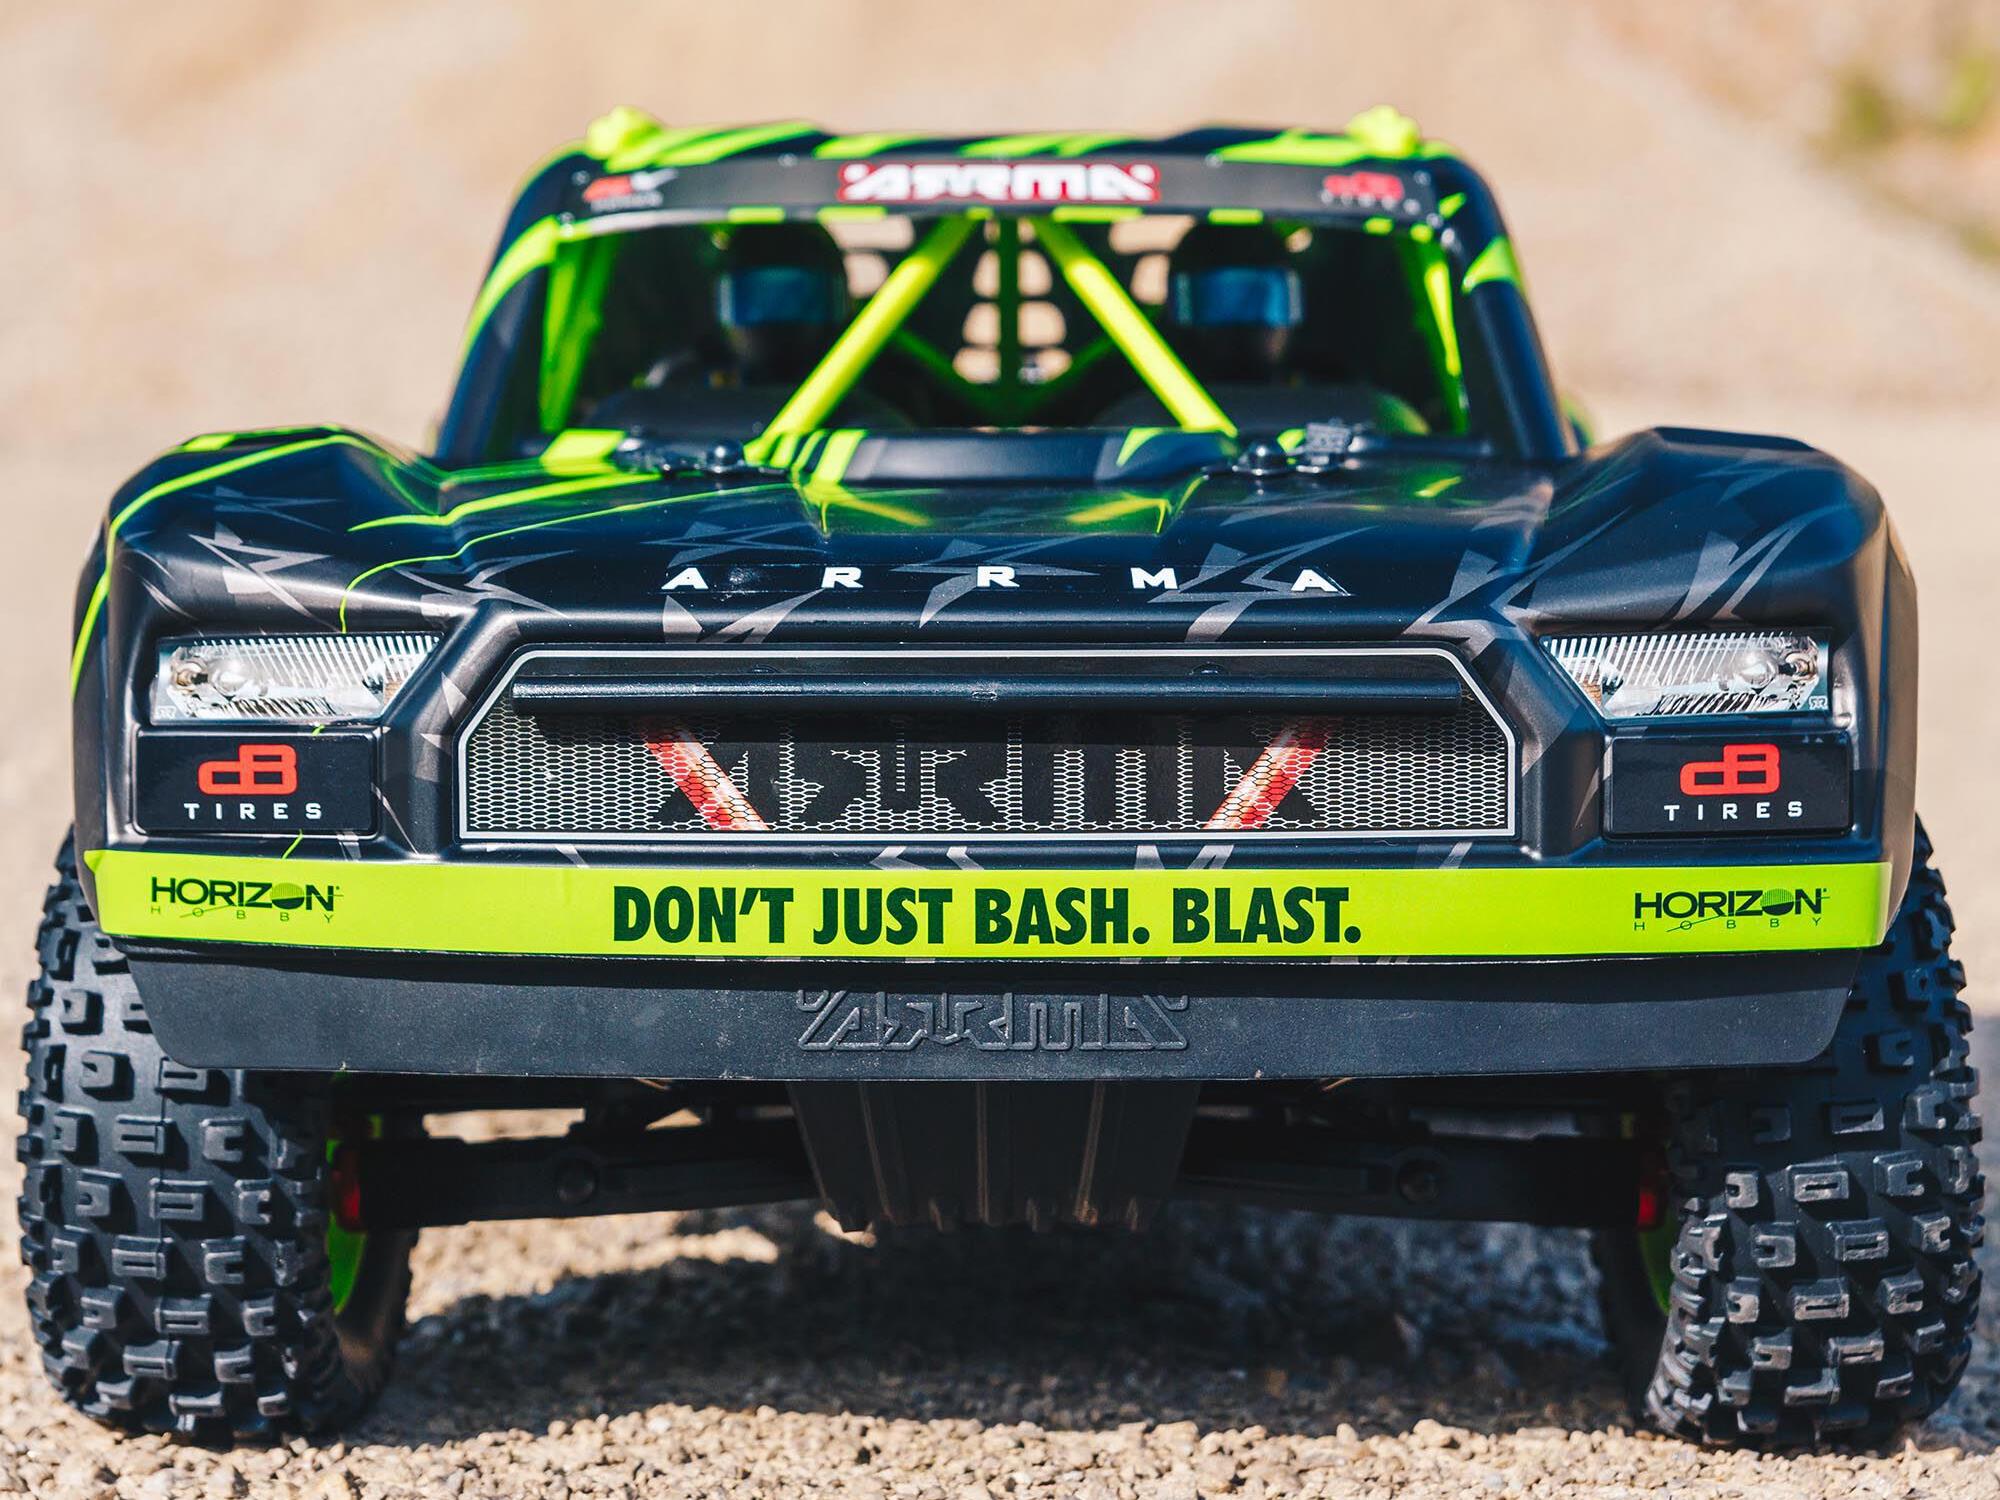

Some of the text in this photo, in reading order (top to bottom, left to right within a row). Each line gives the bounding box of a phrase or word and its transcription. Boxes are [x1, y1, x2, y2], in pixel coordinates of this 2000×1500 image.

[184, 802, 322, 820] TIRES
[1664, 800, 1803, 822] TIRES
[613, 886, 1362, 945] DON'T JUST BASH. BLAST.
